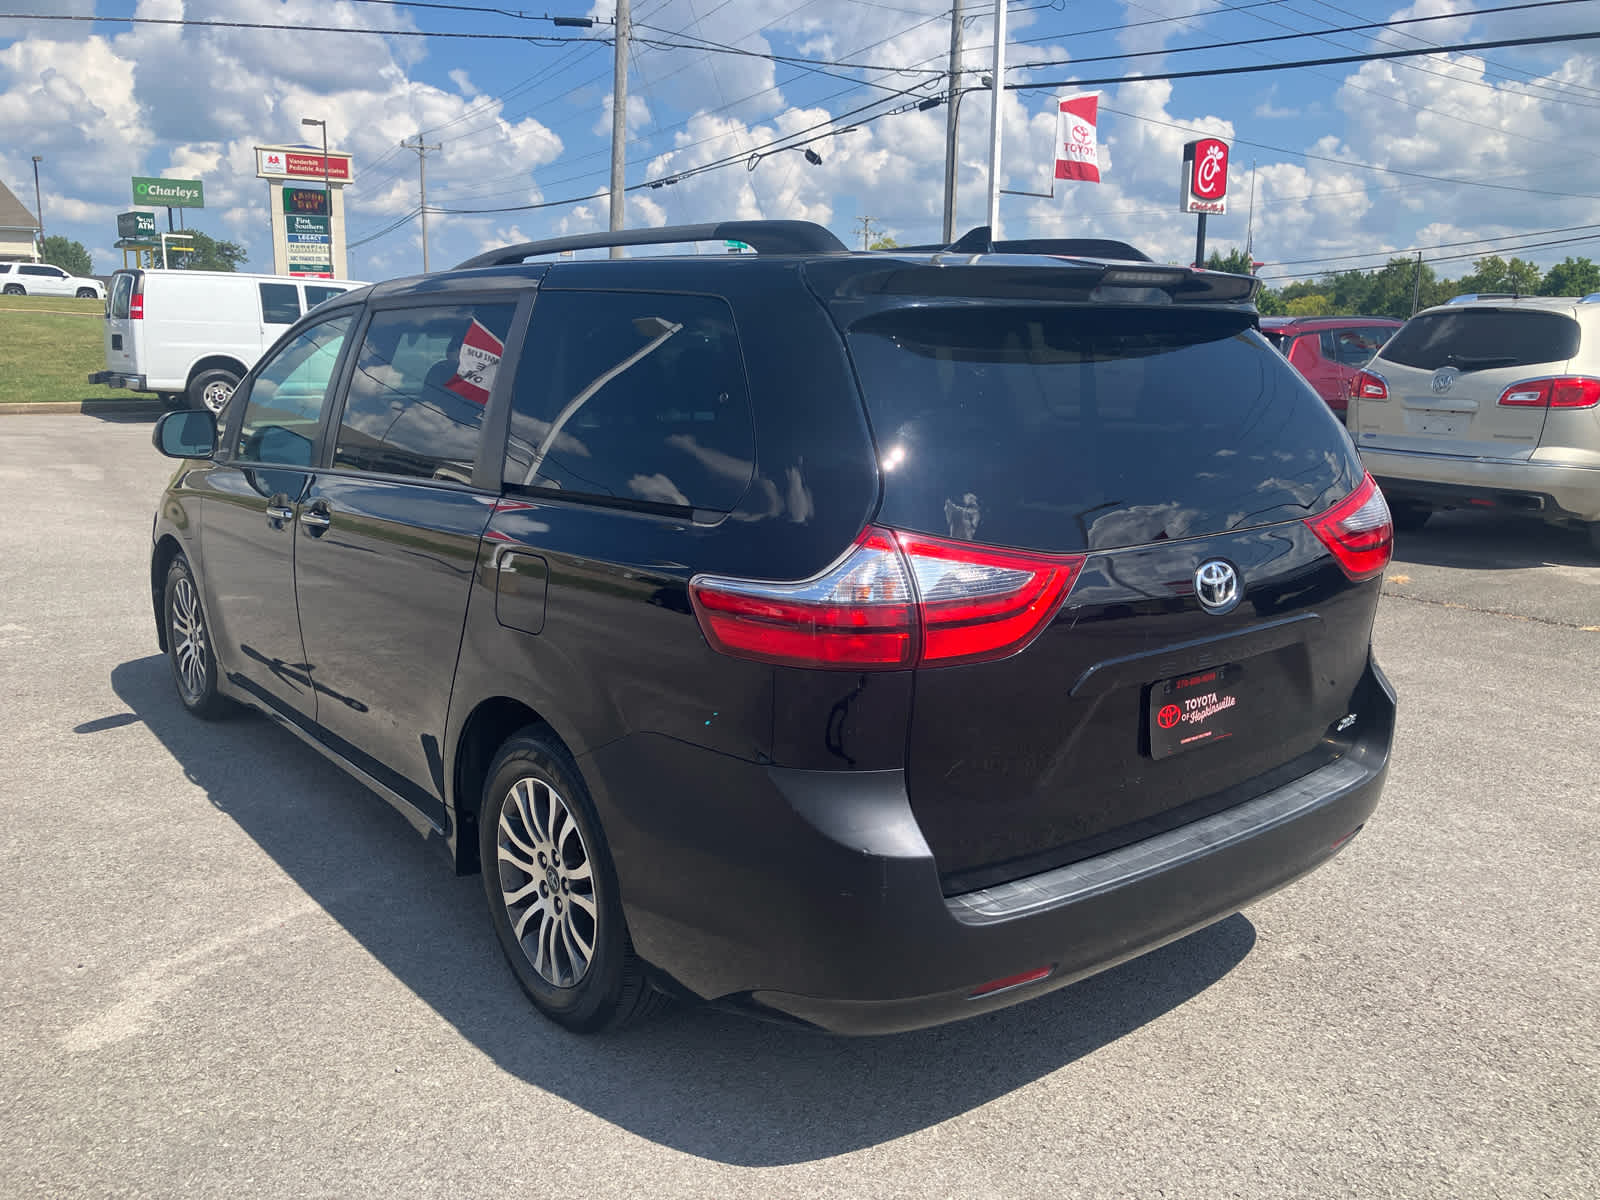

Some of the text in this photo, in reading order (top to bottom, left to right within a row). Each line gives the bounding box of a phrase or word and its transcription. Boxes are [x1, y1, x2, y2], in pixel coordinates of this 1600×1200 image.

[288, 157, 319, 166] Vanderbilt
[288, 163, 314, 172] Pediatric
[315, 165, 345, 174] Assciates
[295, 217, 310, 225] First
[137, 222, 155, 231] ATM
[1185, 692, 1218, 711] TOYOTA
[1181, 695, 1236, 724] OF Hopkinsville
